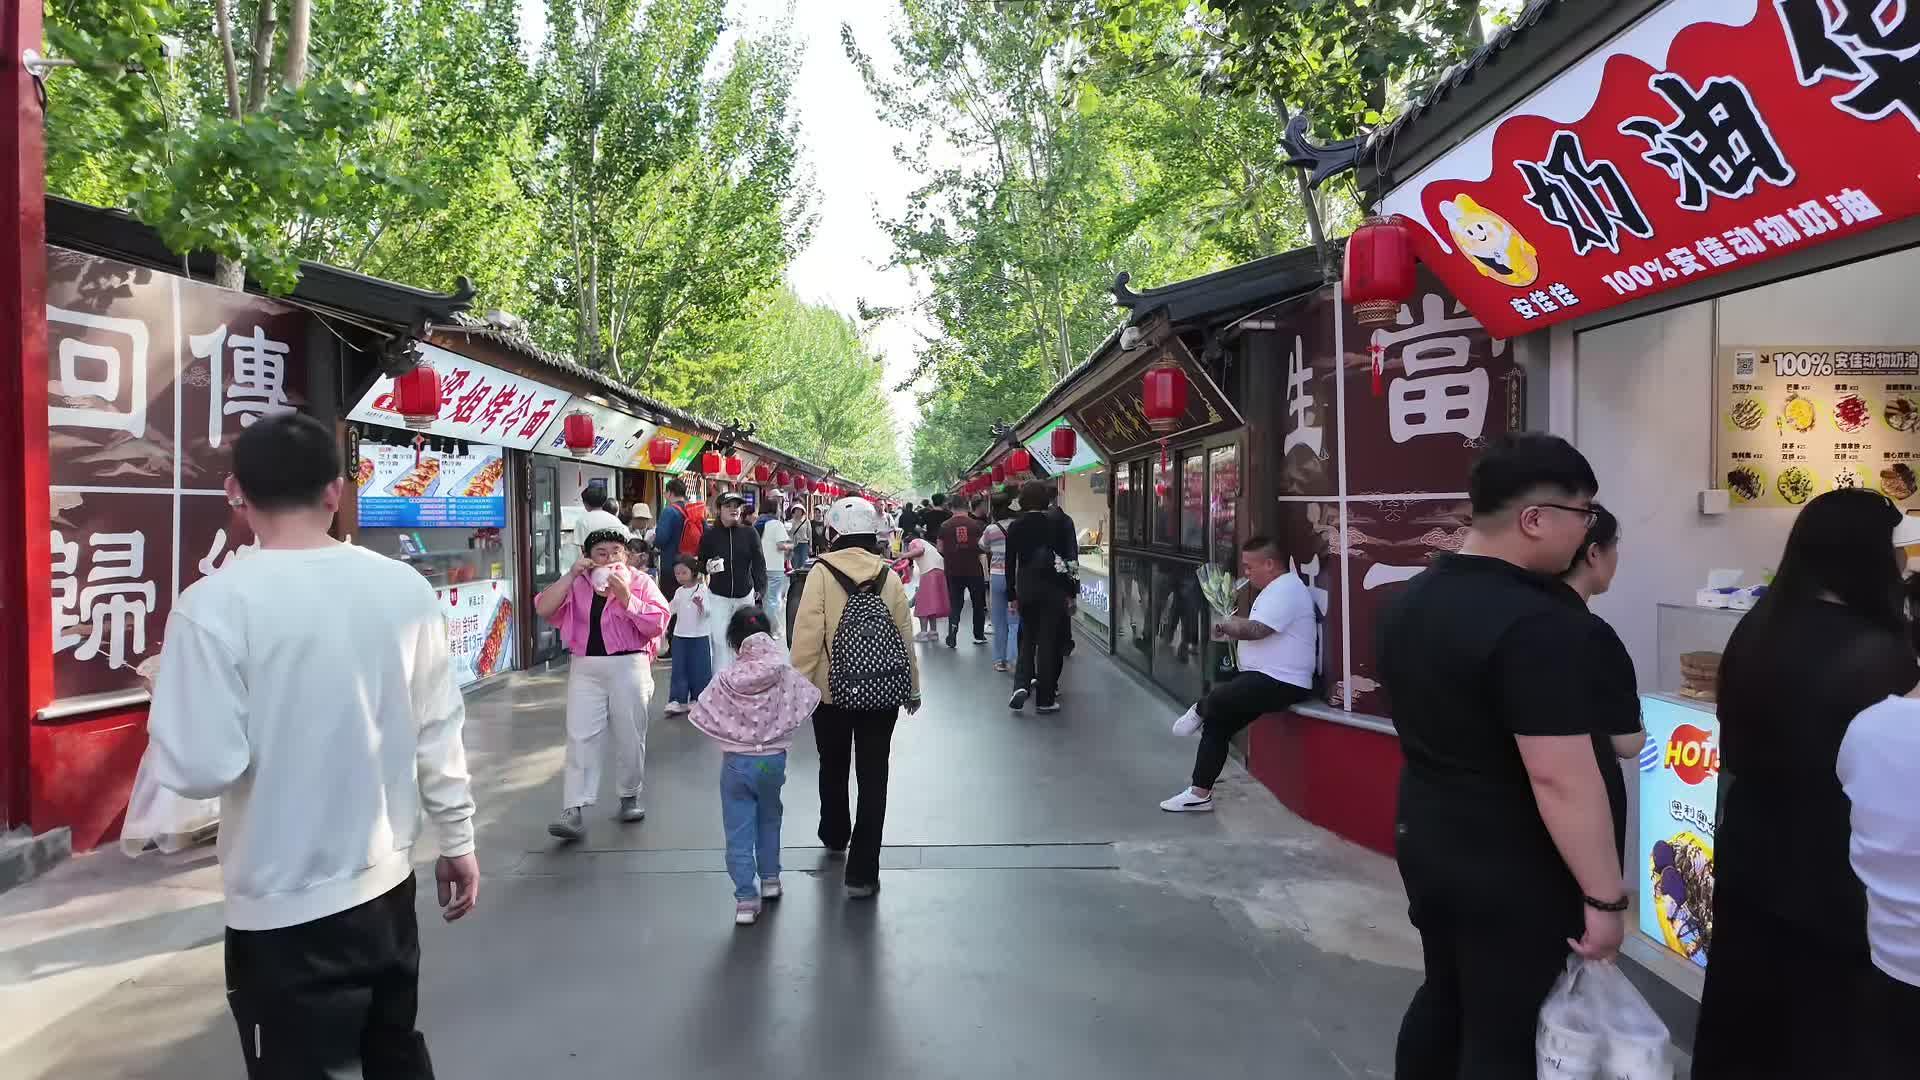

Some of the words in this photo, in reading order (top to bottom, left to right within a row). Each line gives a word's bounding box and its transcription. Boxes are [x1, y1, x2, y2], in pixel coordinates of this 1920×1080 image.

[1601, 187, 1883, 295] 100%安佳动物奶油
[1509, 282, 1581, 320] 安佳佳
[1773, 352, 1832, 376] 100%
[1834, 351, 1919, 369] 安佳动物奶油
